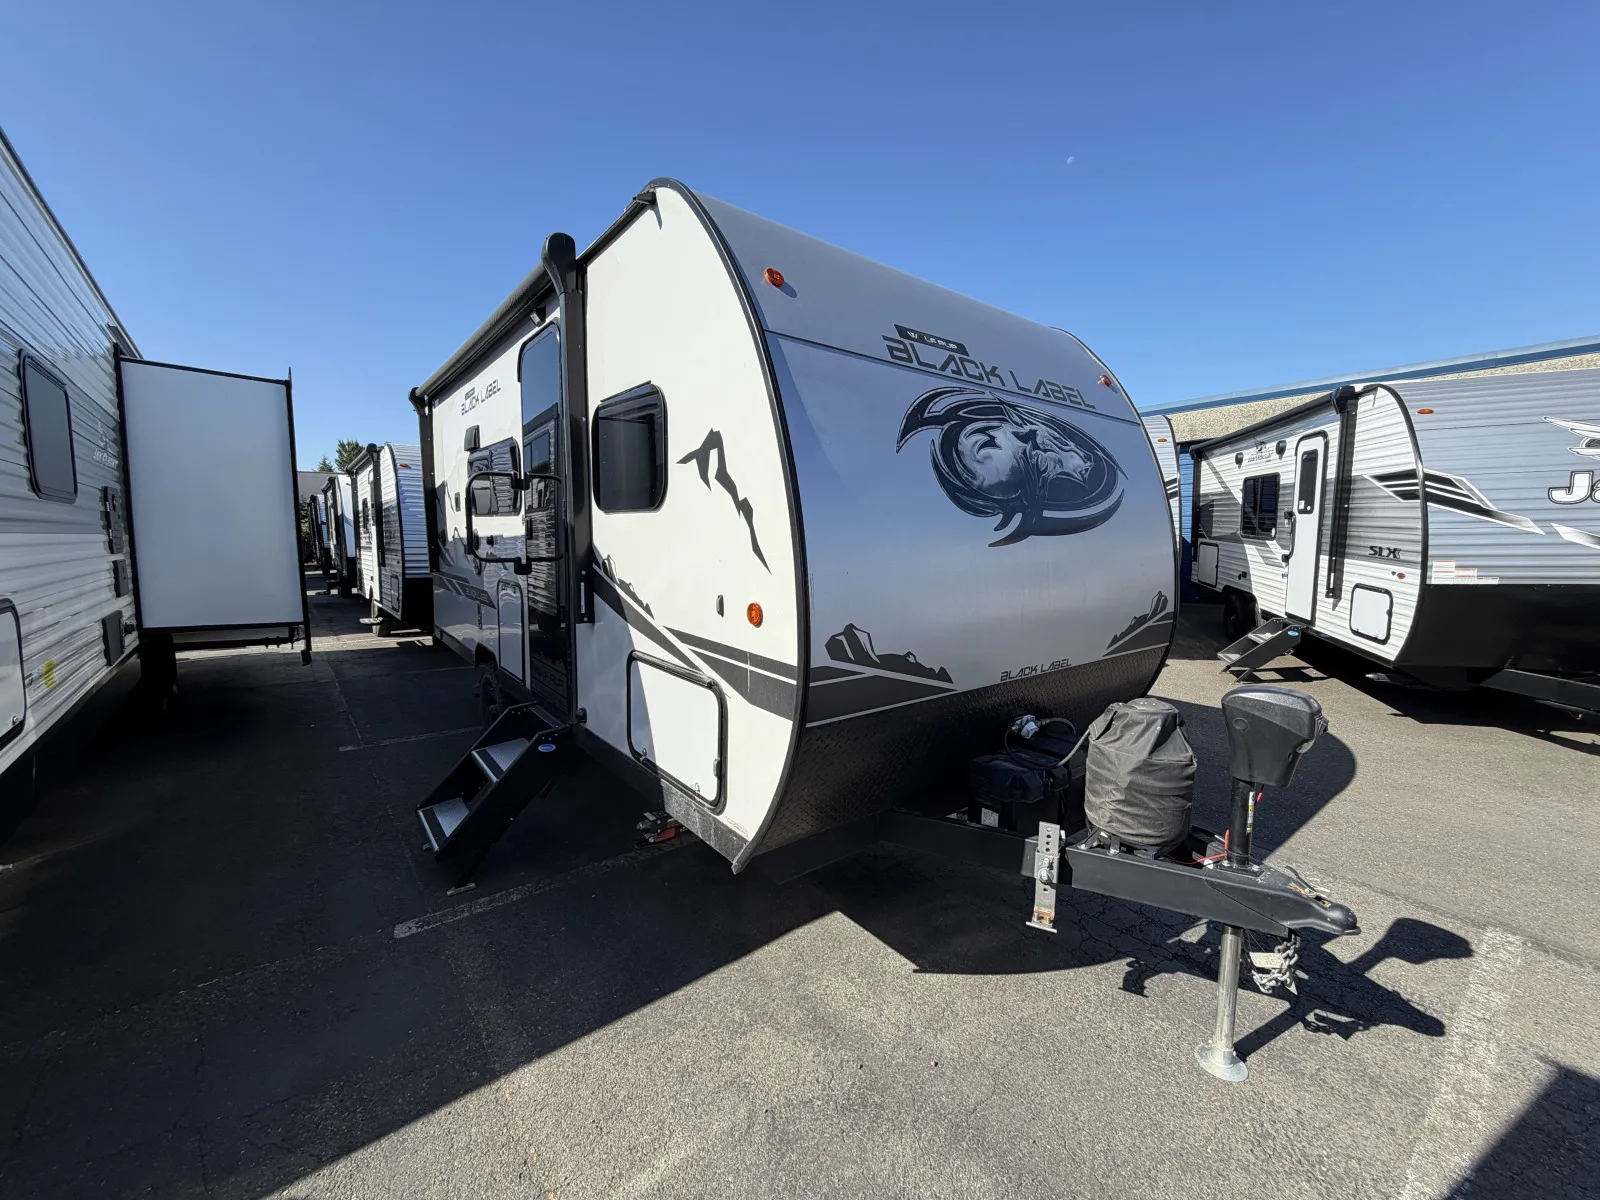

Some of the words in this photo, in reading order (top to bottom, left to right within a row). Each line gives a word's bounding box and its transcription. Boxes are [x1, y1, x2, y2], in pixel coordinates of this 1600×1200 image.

[882, 335, 1006, 387] BLACK
[1009, 370, 1096, 409] LABEL
[481, 378, 501, 403] LABEL
[1548, 471, 1600, 505] J
[1369, 545, 1400, 559] SLX
[1000, 664, 1038, 681] BLACK
[1041, 658, 1072, 673] LABEL
